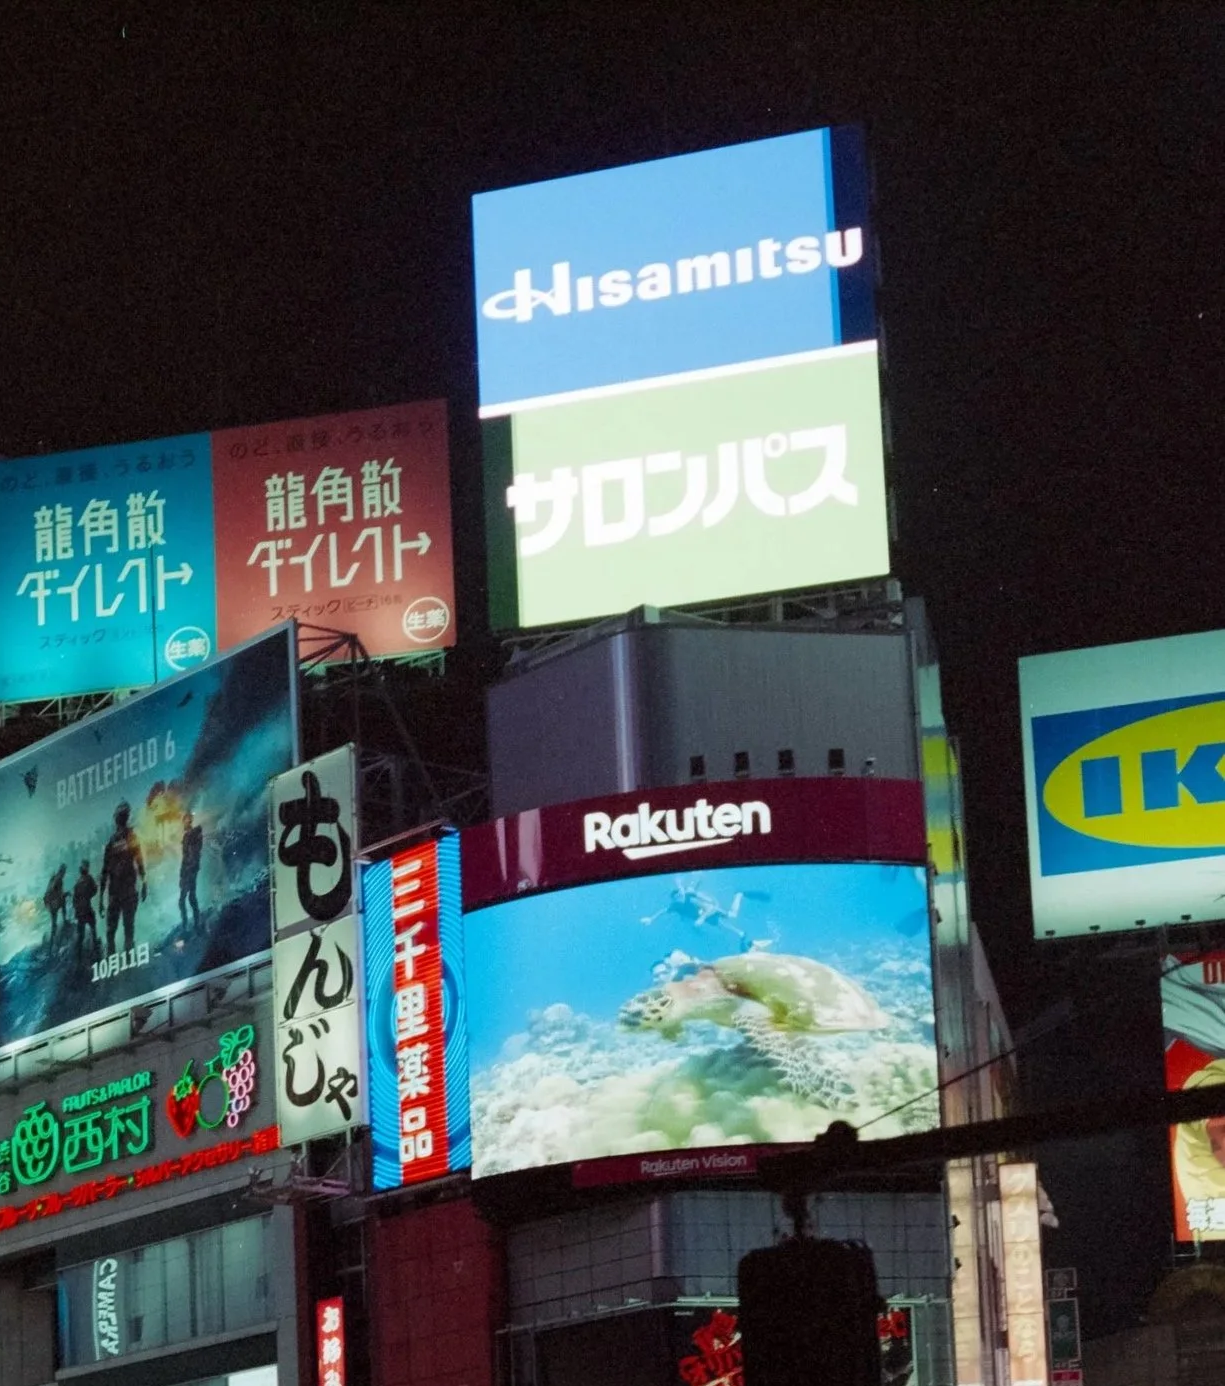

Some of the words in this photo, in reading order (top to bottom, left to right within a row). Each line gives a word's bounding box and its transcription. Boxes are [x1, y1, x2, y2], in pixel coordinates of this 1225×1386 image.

[482, 227, 863, 321] Hisamitsu
[33, 489, 167, 562] 龍角散
[265, 457, 404, 532] 龍角散
[506, 424, 859, 558] サロンパス
[16, 557, 193, 626] ダイレクト
[246, 524, 431, 597] ダイレクト
[40, 628, 107, 649] スティック
[271, 600, 342, 621] スティック
[407, 610, 447, 630] 生薬
[168, 636, 207, 660] 生薬
[56, 737, 158, 811] BATTLEFIELD
[165, 729, 176, 760] 6
[583, 799, 772, 857] Rakuten
[278, 770, 359, 1121] もんじゃ
[392, 858, 436, 1163] 三千里薬品
[63, 1096, 151, 1174] 西村
[640, 1155, 699, 1175] Rakuten
[701, 1152, 748, 1169] Vision
